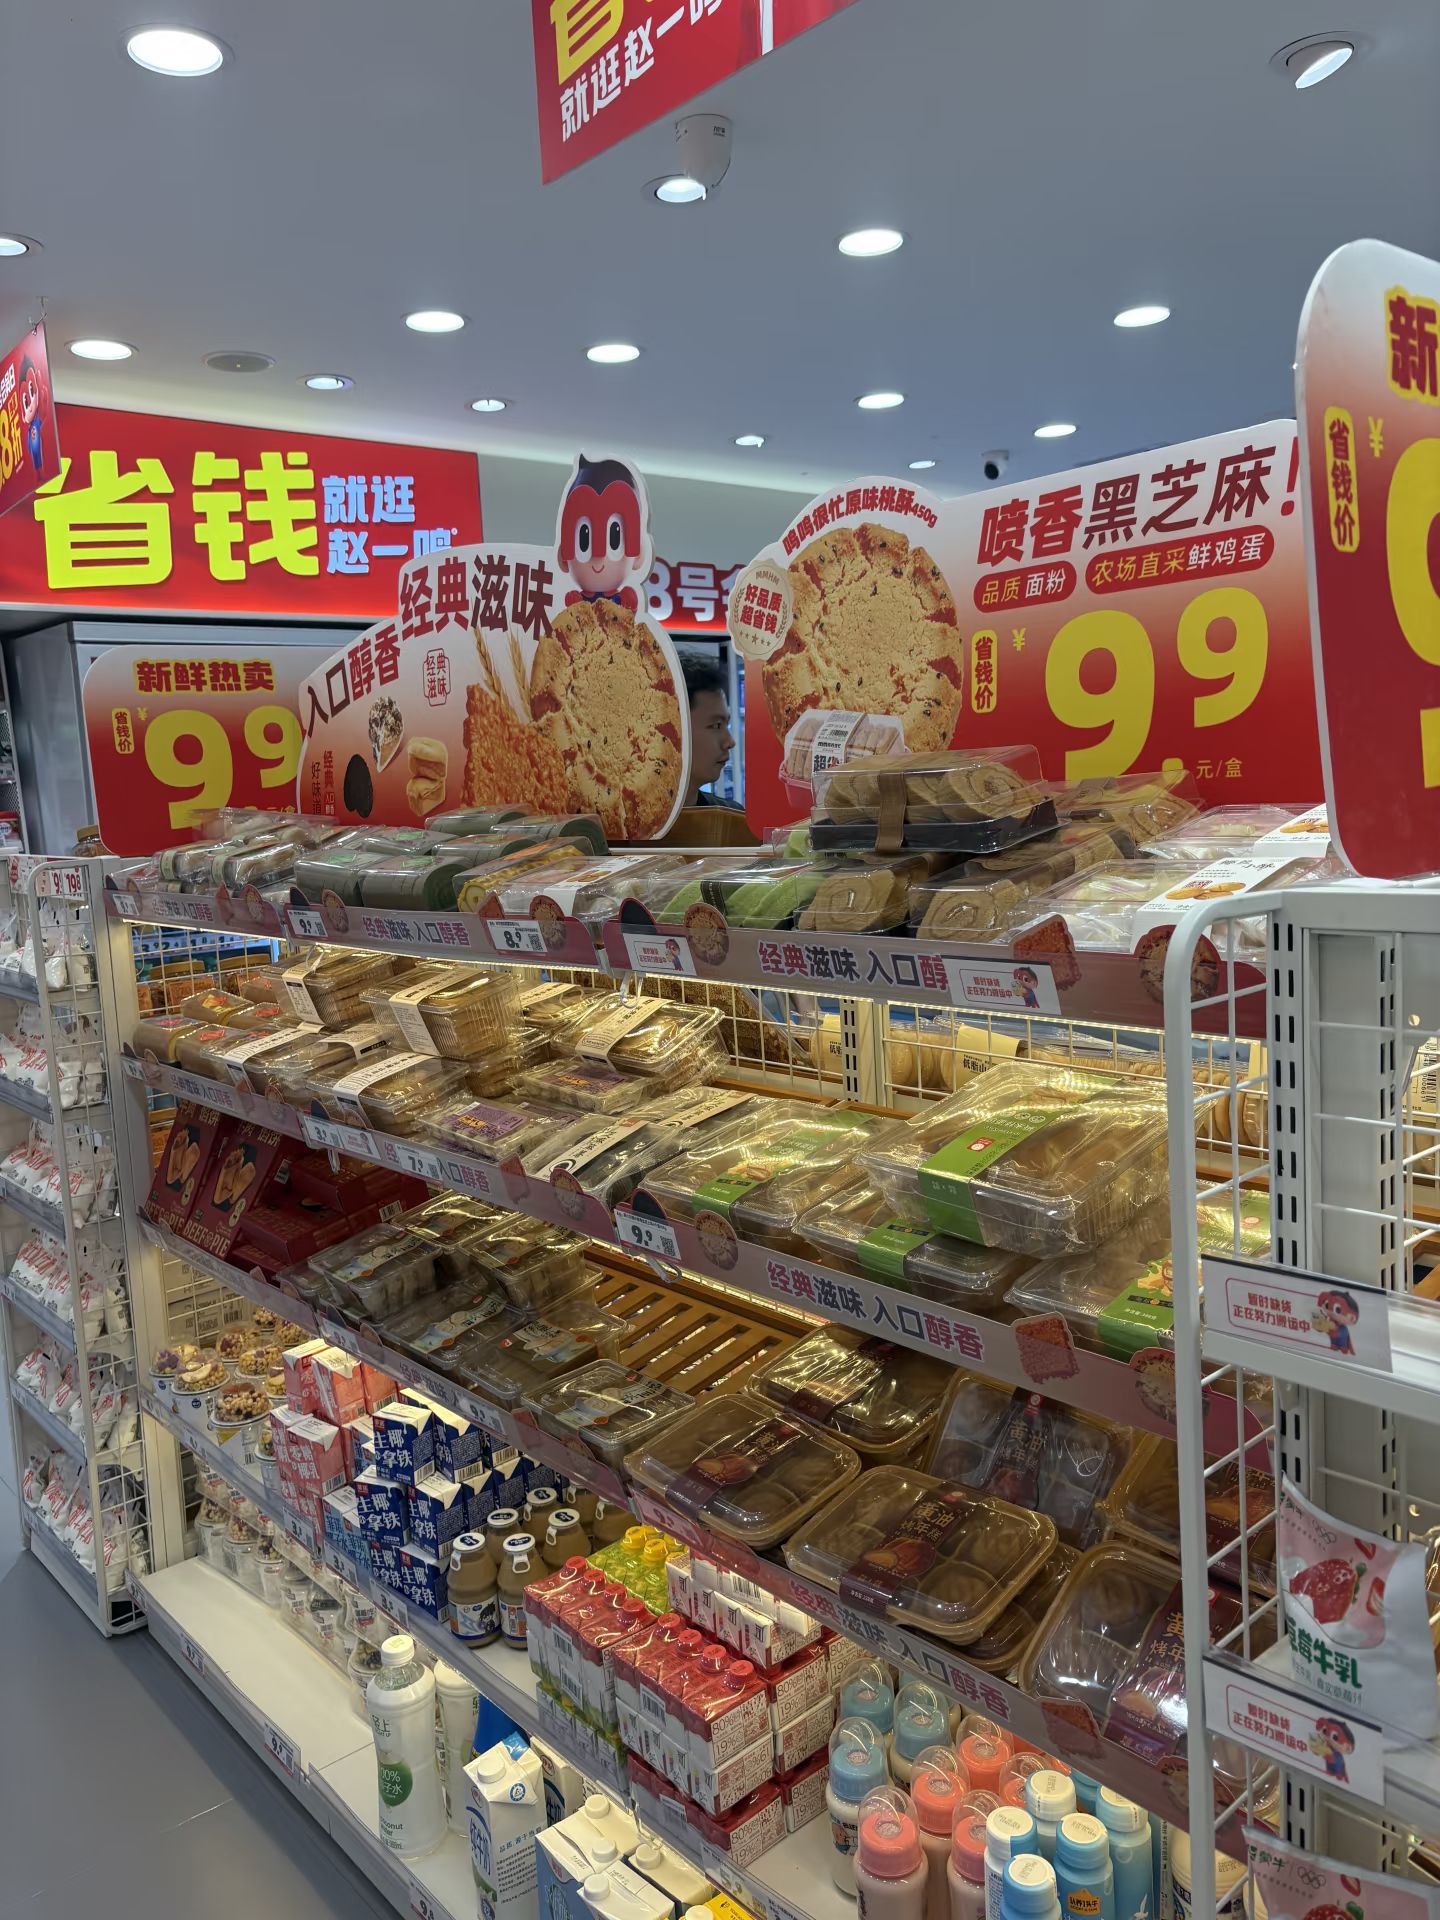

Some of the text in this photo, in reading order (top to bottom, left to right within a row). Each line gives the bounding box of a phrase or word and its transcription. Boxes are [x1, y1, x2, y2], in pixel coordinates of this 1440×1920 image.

[560, 0, 722, 142] 就逛赵一
[1389, 296, 1439, 396] 新
[1367, 416, 1384, 457] ¥
[322, 475, 416, 523] 就逛
[1329, 418, 1355, 547] 省钱价
[34, 450, 319, 590] 省钱
[1091, 532, 1267, 587] 农场直采鲜鸡蛋
[400, 554, 554, 642] 经典滋味
[744, 583, 783, 613] 好品质
[740, 605, 778, 634] 超省钱
[136, 661, 275, 692] 新鲜热卖
[308, 624, 401, 738] 入口醇香
[975, 636, 994, 711] 省钱价
[1012, 628, 1027, 651] ¥
[1195, 757, 1243, 778] 元/盒
[114, 711, 132, 753] 省钱价
[363, 916, 414, 942] 经典滋味
[415, 922, 471, 947] 入口醇香
[503, 930, 522, 949] 8.9
[758, 941, 861, 983] 经典滋味
[438, 1157, 491, 1193] 入口醇香
[631, 1224, 654, 1248] 9.9
[767, 1259, 985, 1363] 经典滋味 入口醇香
[1232, 1304, 1311, 1333] 正在努力搬运中
[1009, 1418, 1046, 1453] 黄油
[382, 1450, 413, 1469] 拿铁
[368, 1511, 401, 1532] 拿铁
[913, 1501, 955, 1528] 黄油
[400, 1566, 428, 1586] 生椰
[410, 1585, 436, 1607] 拿铁
[788, 1579, 1012, 1723] 经典滋味 入口醇香
[776, 1676, 798, 1697] 80%
[711, 1713, 734, 1736] 80%
[1232, 1711, 1309, 1753] 正在努力搬运中
[714, 1735, 738, 1756] 19%
